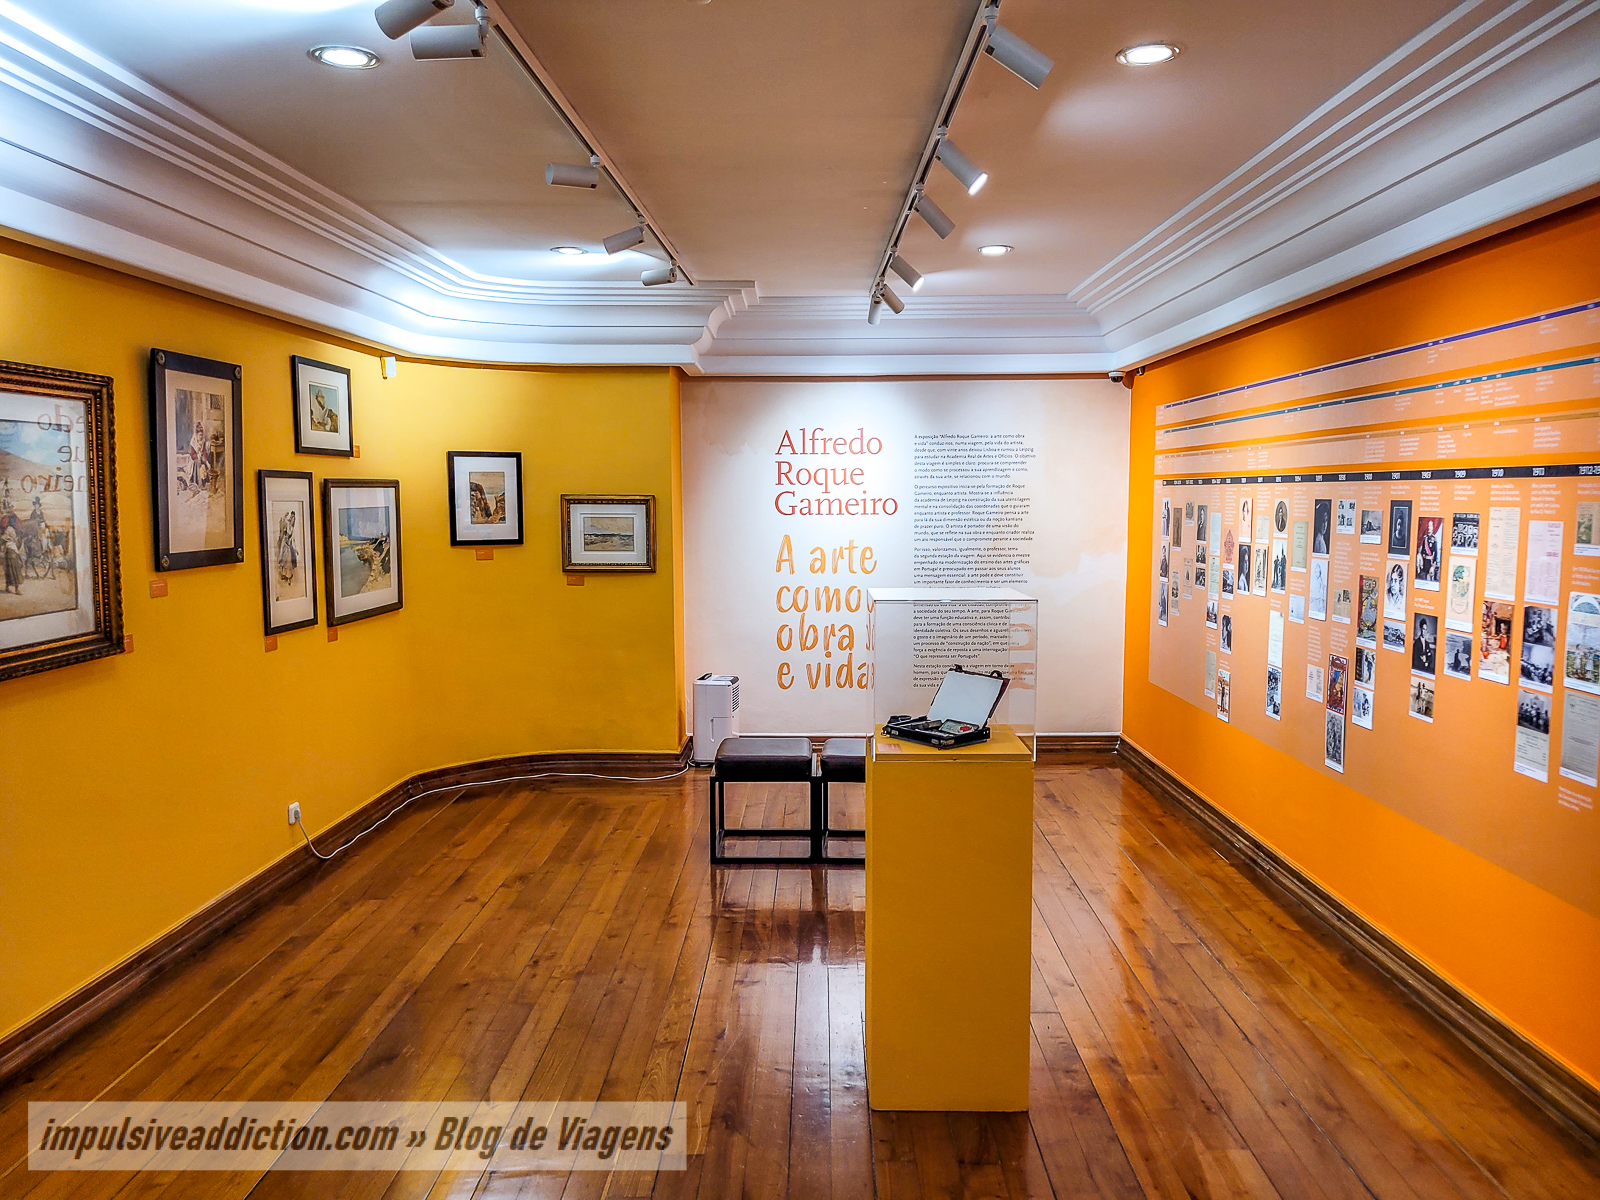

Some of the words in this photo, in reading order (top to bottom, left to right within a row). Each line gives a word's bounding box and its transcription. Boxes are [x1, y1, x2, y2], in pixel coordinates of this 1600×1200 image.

[775, 428, 882, 455] Alfredo
[774, 461, 864, 494] Roque
[774, 490, 898, 516] Gameiro
[776, 534, 795, 575] A
[809, 539, 878, 575] arte
[776, 585, 861, 613] como
[776, 612, 854, 652] obra
[777, 662, 794, 690] e
[806, 651, 869, 690] vida
